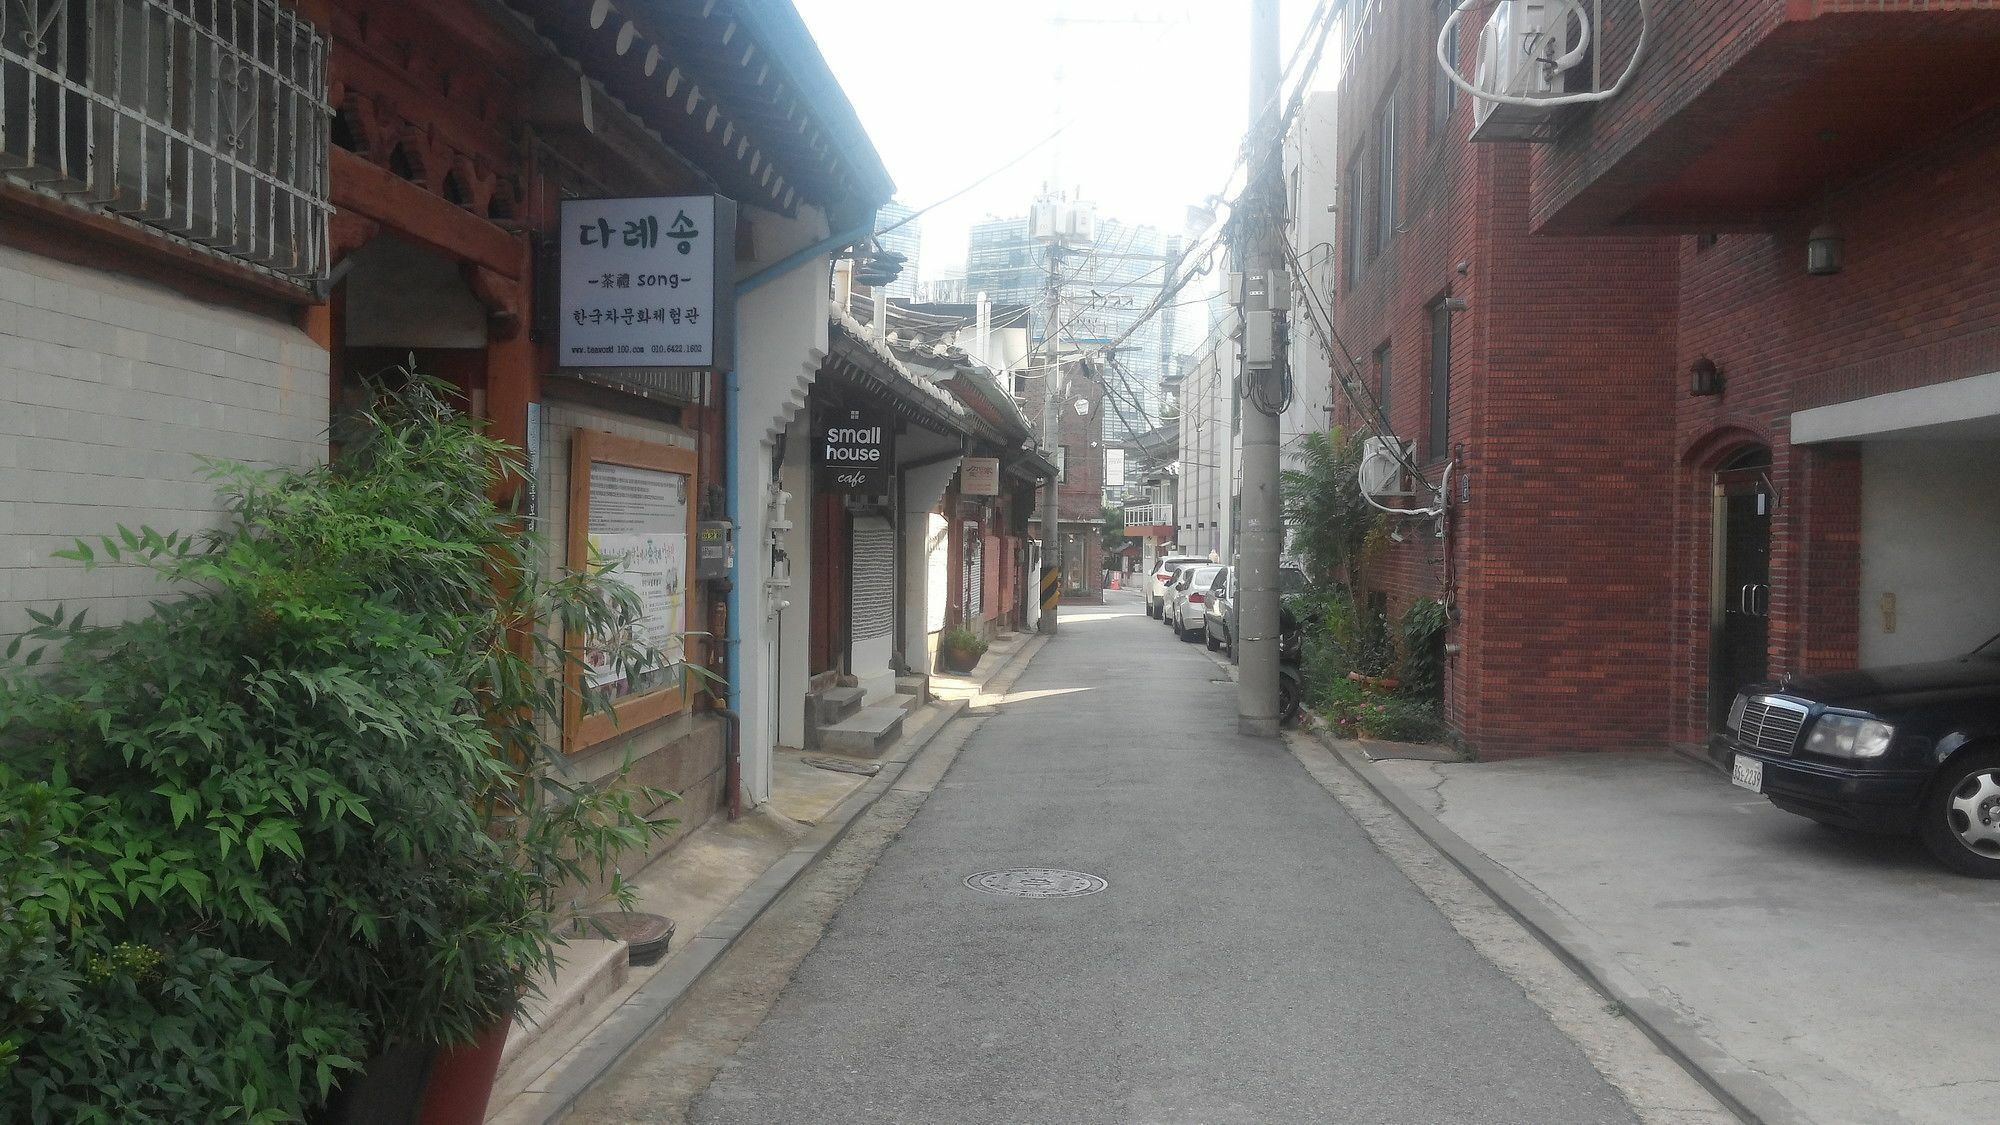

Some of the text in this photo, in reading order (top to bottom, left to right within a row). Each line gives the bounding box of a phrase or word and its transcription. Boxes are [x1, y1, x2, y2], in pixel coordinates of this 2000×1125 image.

[573, 306, 700, 327] 한국차문화체험관
[827, 426, 881, 444] small
[826, 445, 880, 462] house
[837, 471, 867, 488] cafe
